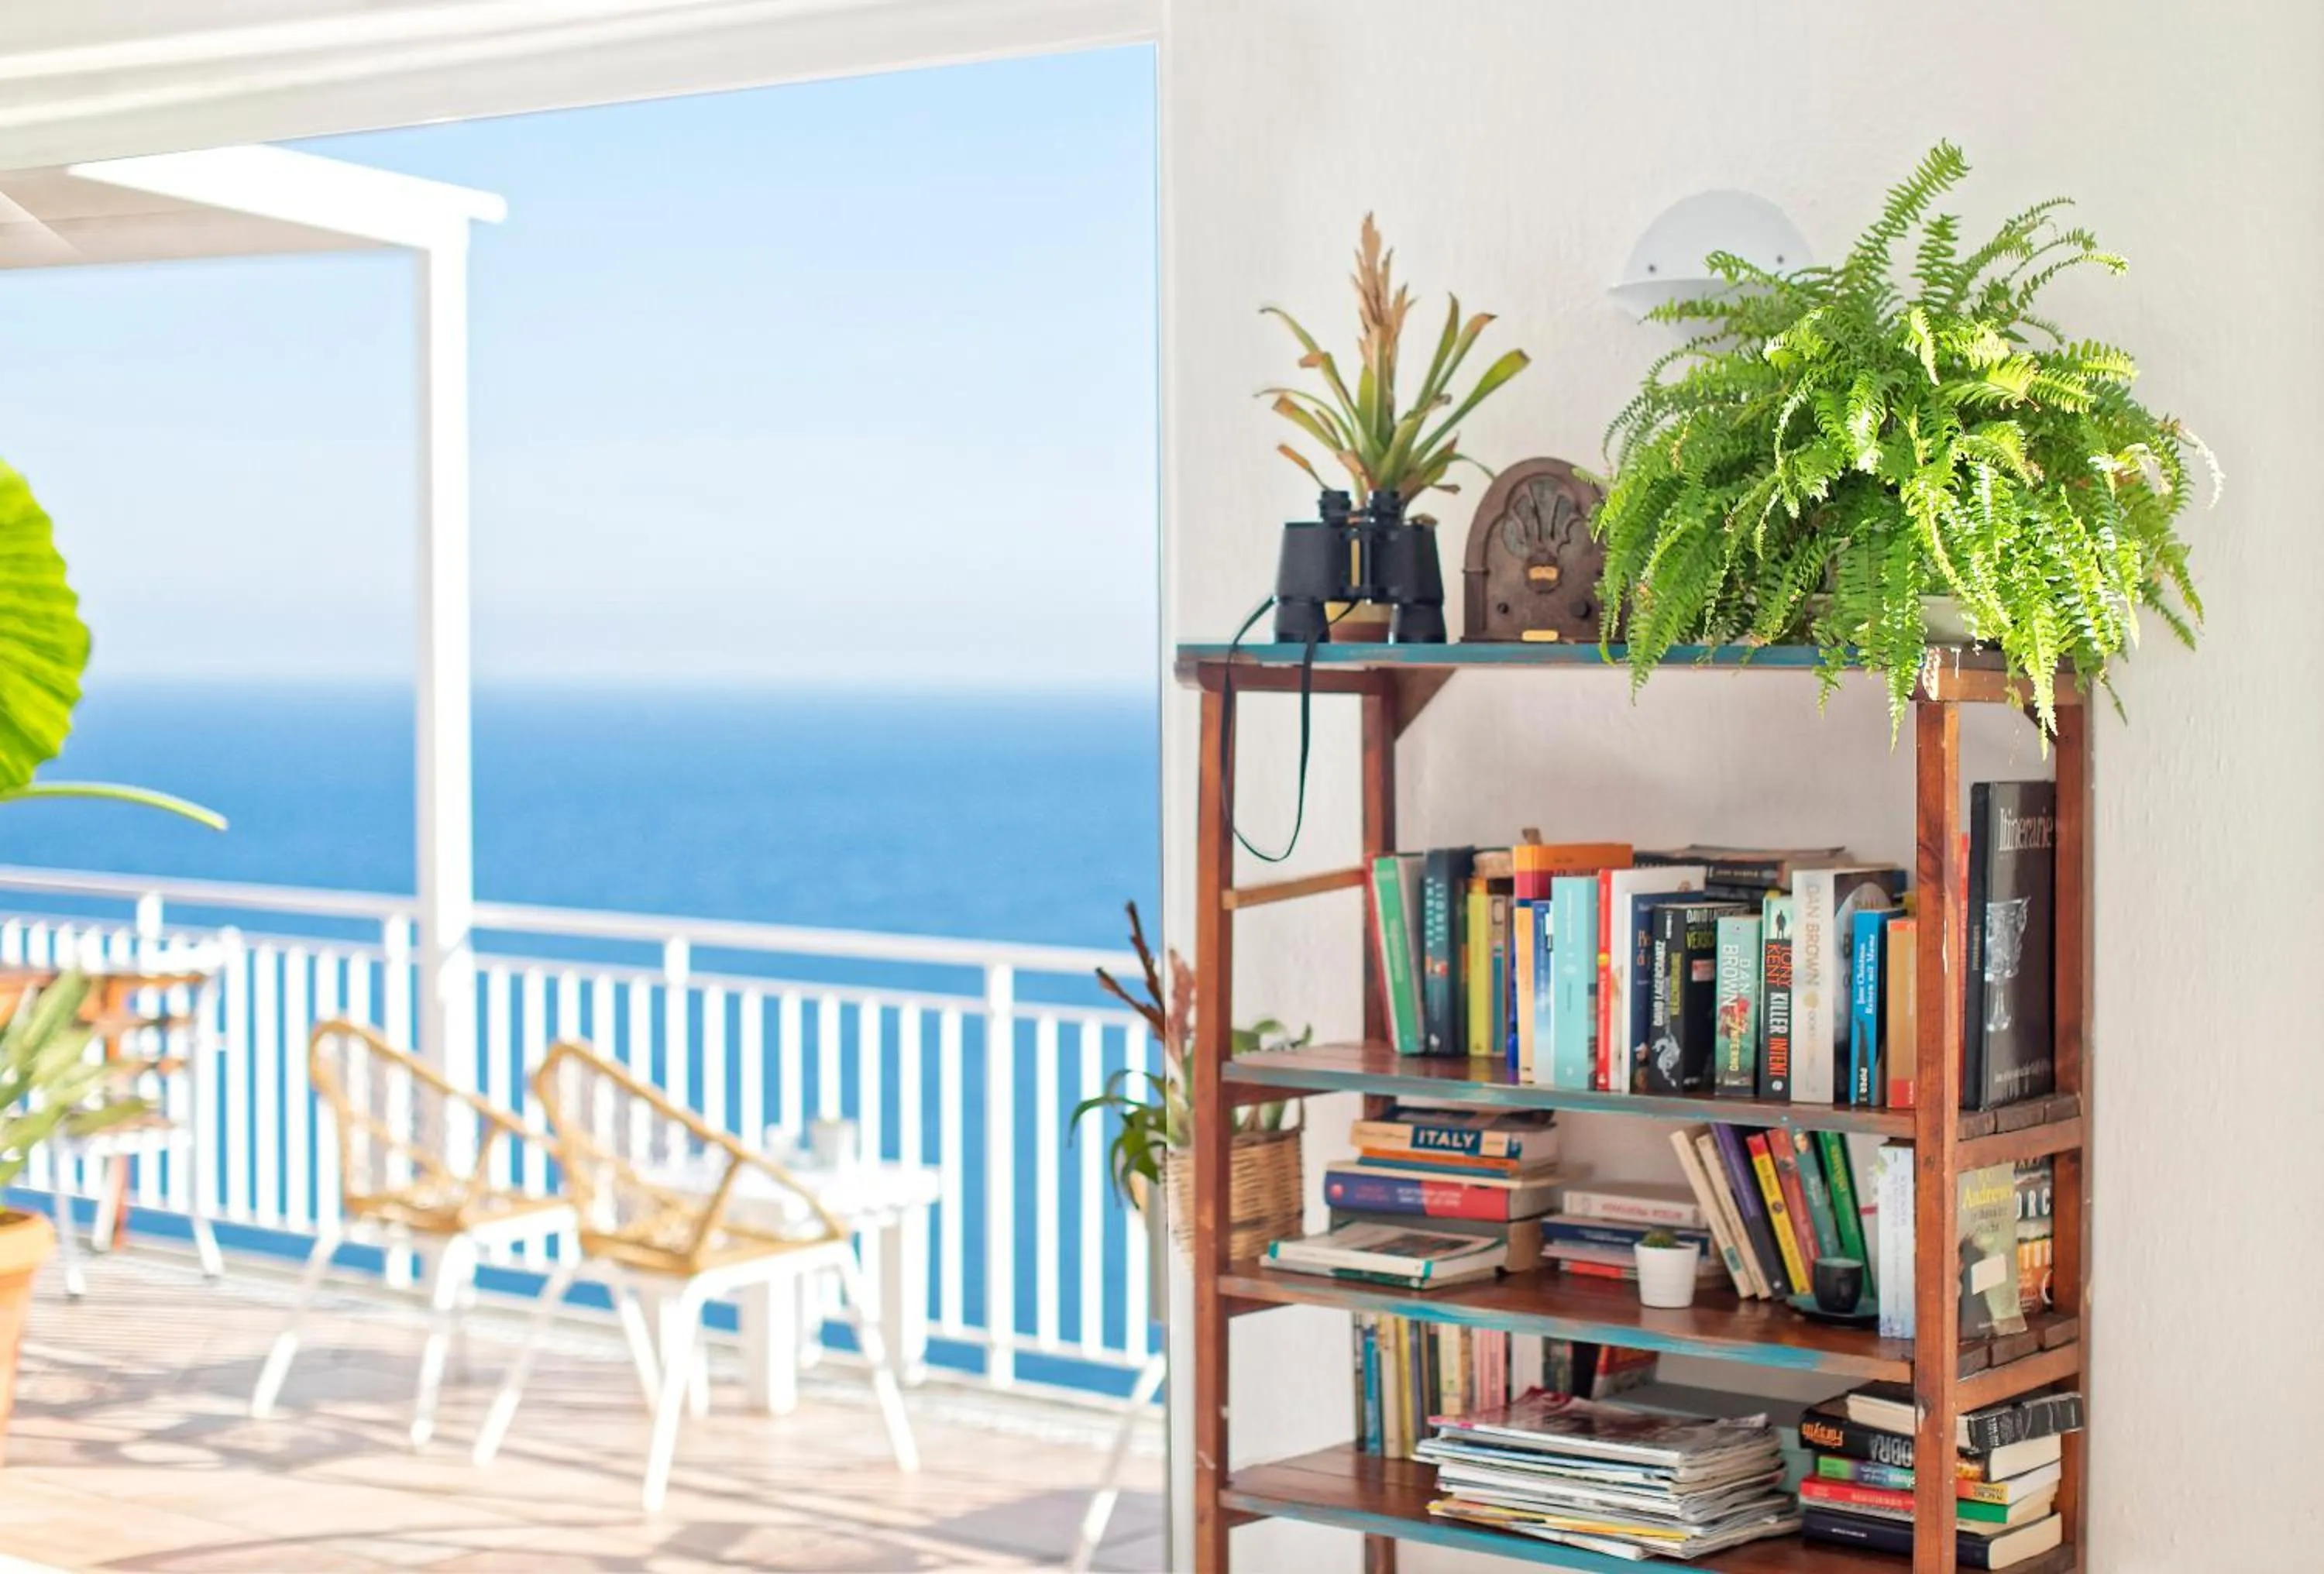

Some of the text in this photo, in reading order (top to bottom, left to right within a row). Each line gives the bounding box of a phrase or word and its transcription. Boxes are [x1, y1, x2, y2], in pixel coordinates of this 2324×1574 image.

[1806, 884, 1820, 986] DAN BROWN
[1721, 944, 1739, 1007] BROWN
[1739, 958, 1752, 993] DAN
[1765, 943, 1779, 987] KENT
[1779, 945, 1793, 988] TONY
[1768, 991, 1789, 1077] KILLER INTENT
[1859, 1067, 1868, 1093] PIPER
[1417, 1129, 1476, 1149] ITALY
[1802, 1422, 1844, 1449] Forsyth
